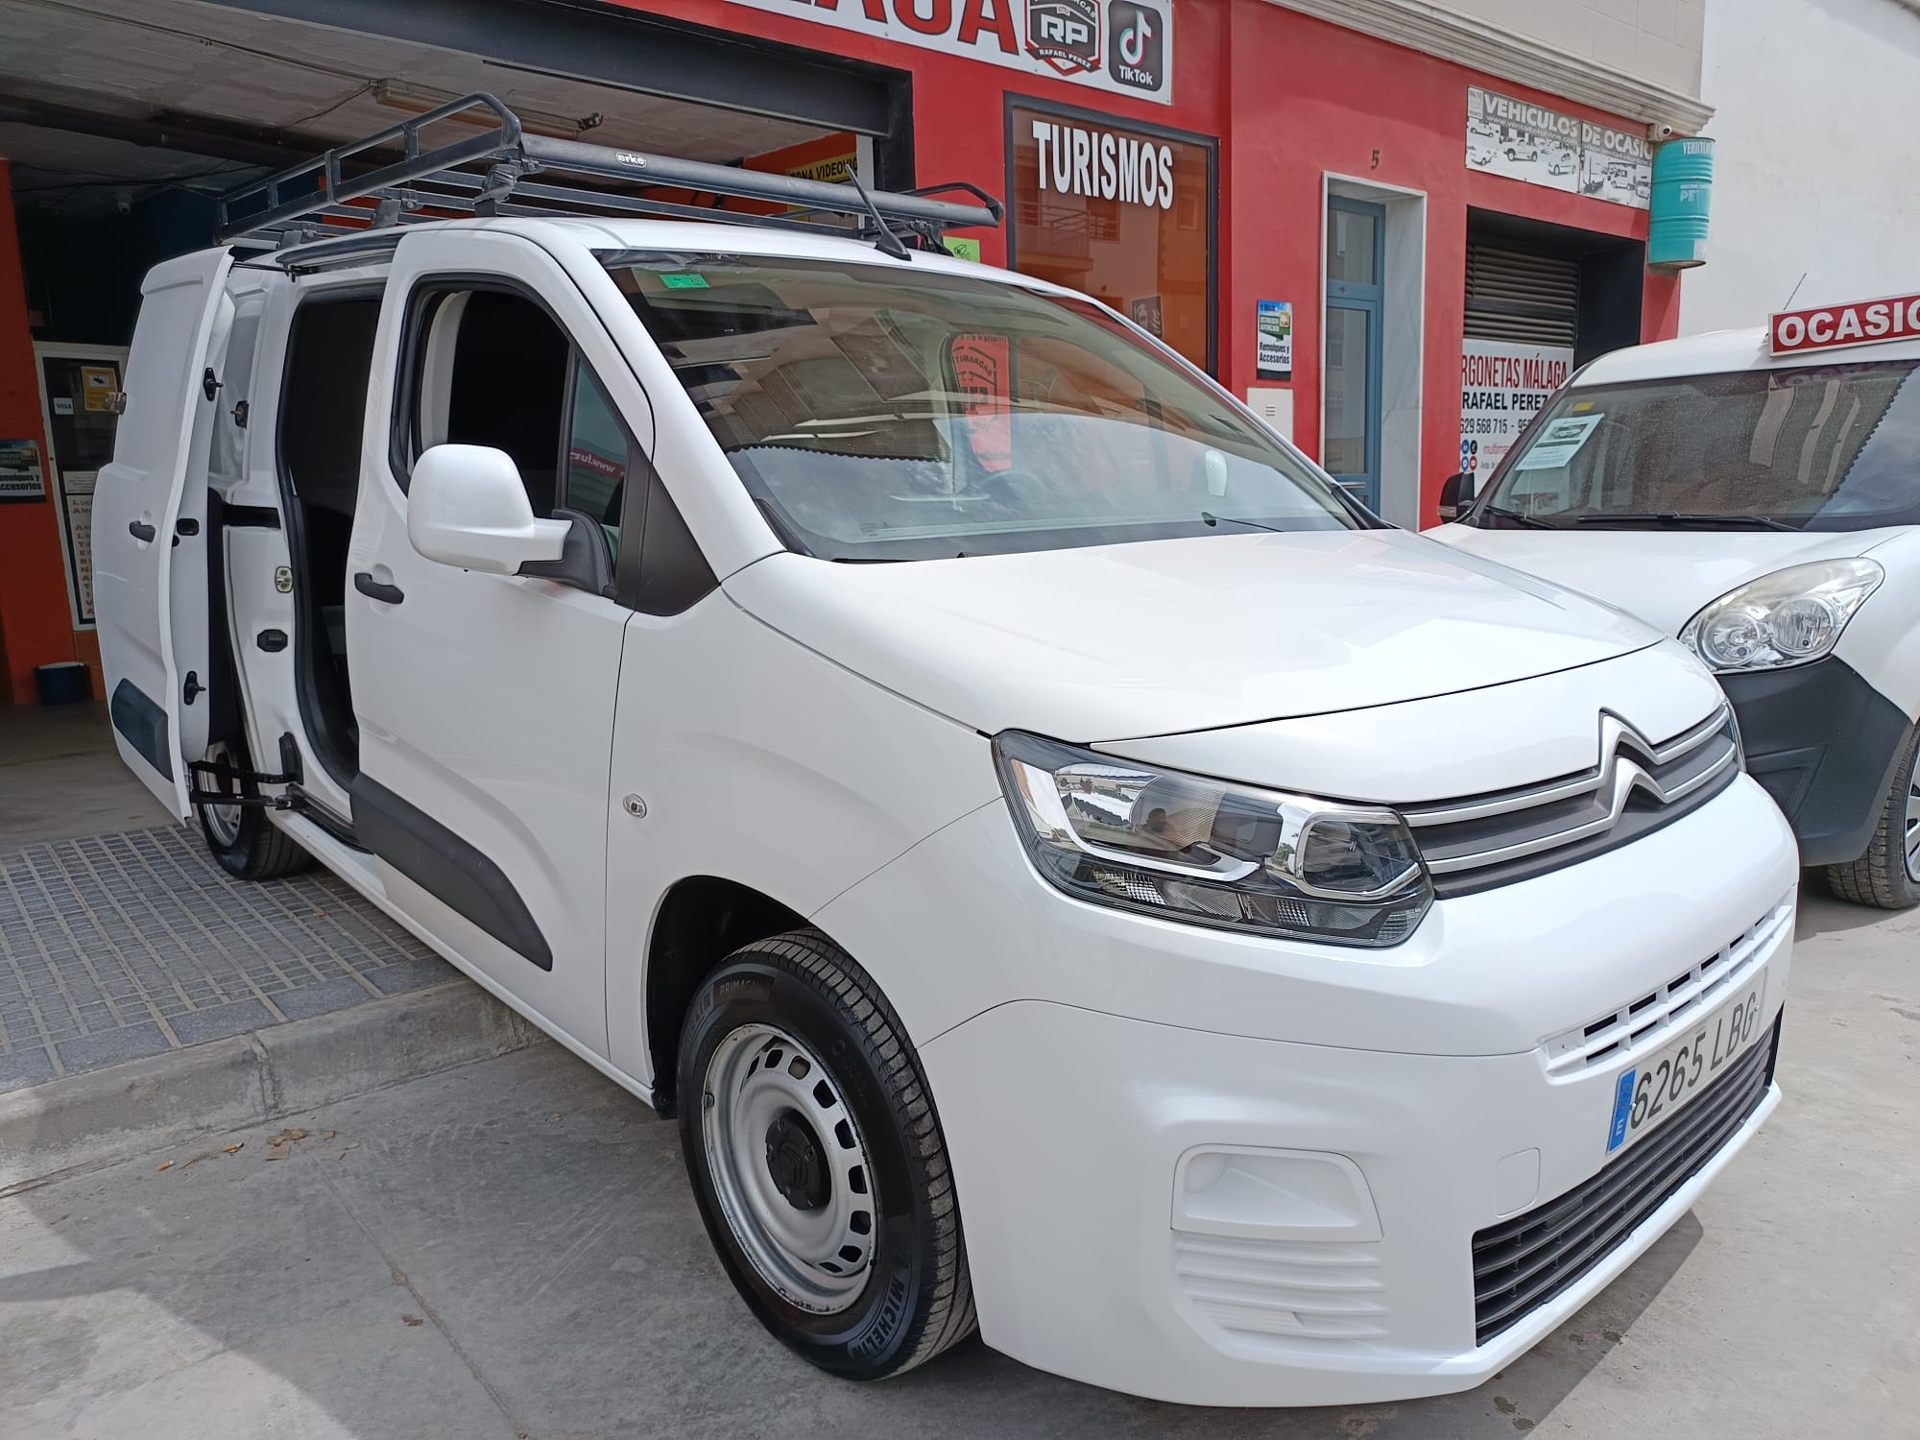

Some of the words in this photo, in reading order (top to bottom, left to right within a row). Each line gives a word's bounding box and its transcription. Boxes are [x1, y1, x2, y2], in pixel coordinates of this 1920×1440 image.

[1040, 13, 1088, 45] RP
[1039, 49, 1068, 59] RAFAEL
[1068, 53, 1092, 69] PEREZ
[1119, 65, 1153, 86] TikTok
[1484, 93, 1579, 138] VEHICULOS
[1582, 122, 1602, 146] DE
[1032, 120, 1174, 210] TURISMOS
[1370, 148, 1380, 170] 5
[1259, 342, 1286, 354] Remolques
[1259, 352, 1290, 364] Accesorios
[1523, 353, 1567, 389] MÁLAGA
[1462, 391, 1508, 410] RAFAEL
[1476, 419, 1491, 434] 568
[1493, 419, 1507, 434] 715
[1630, 1030, 1707, 1130] 6265
[1710, 991, 1757, 1072] LBG
[1615, 1117, 1625, 1136] E
[850, 1274, 905, 1359] MICHELIN
